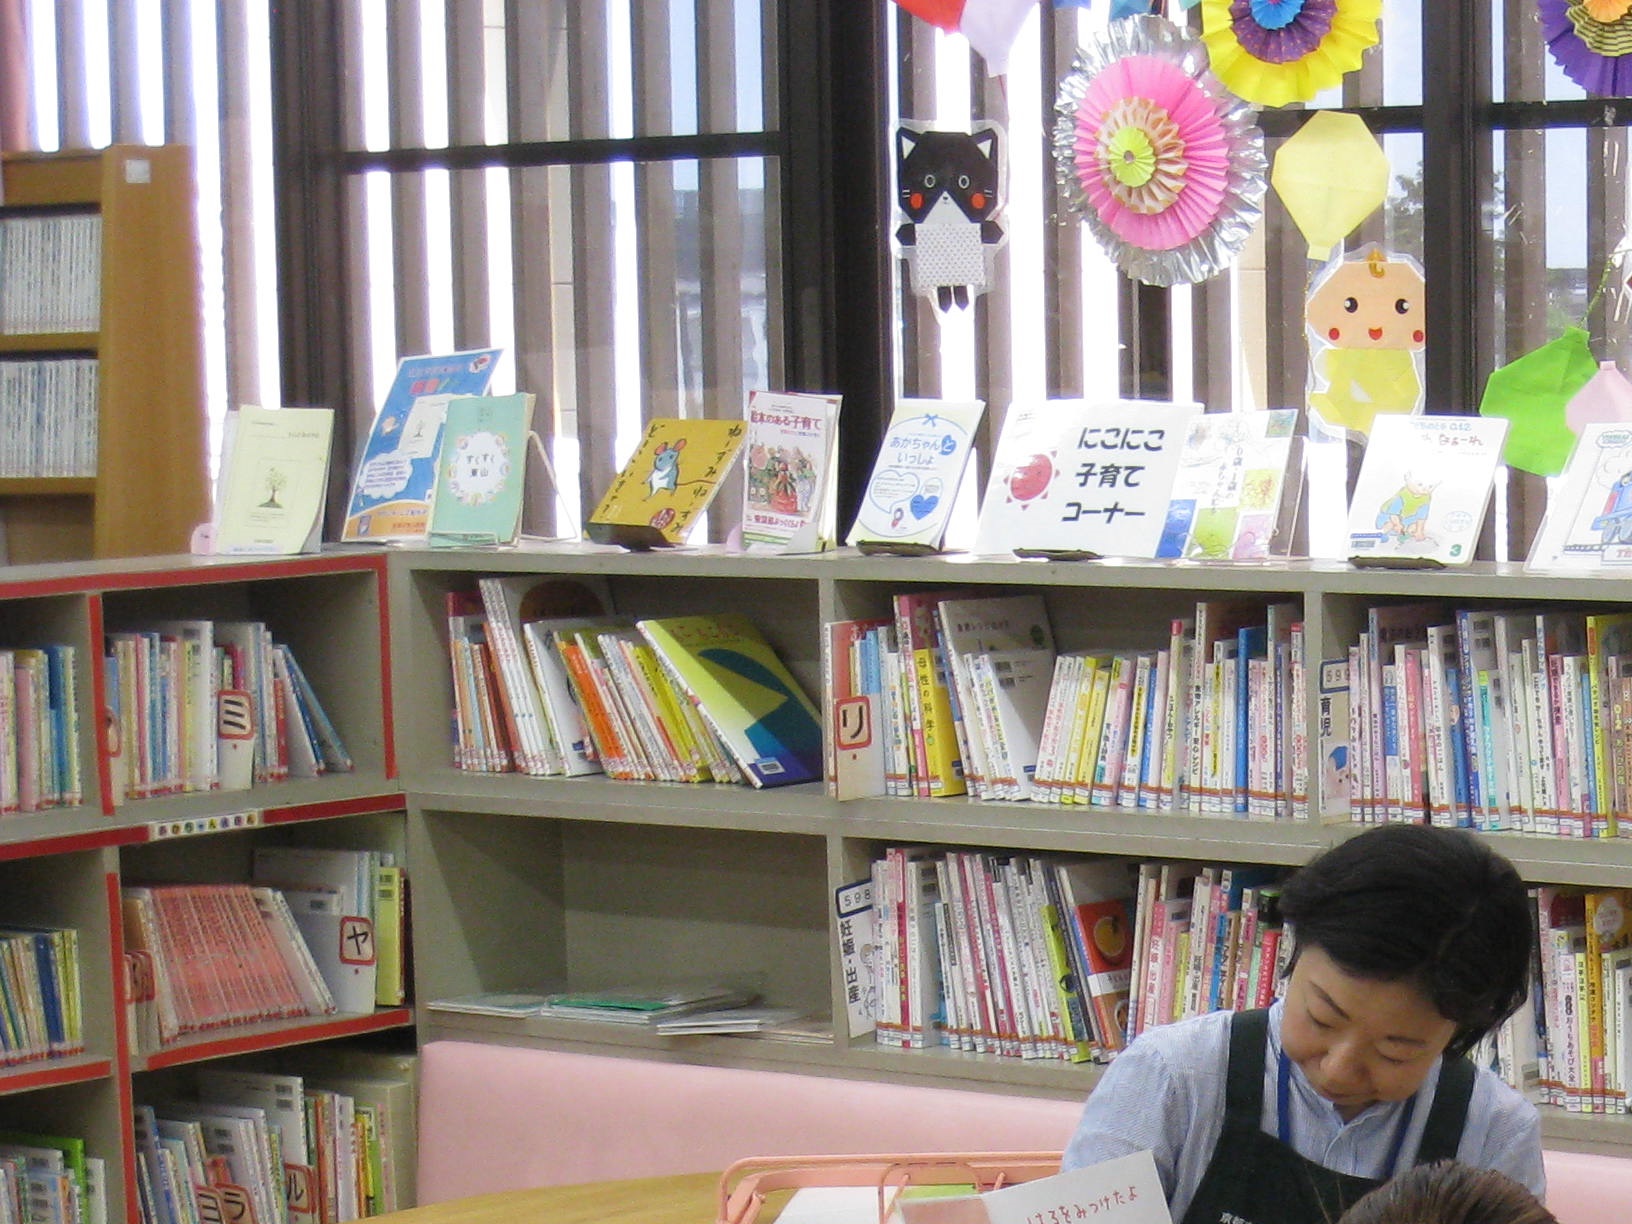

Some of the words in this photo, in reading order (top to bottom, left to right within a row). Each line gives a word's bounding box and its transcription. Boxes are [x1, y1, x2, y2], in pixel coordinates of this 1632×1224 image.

[1077, 427, 1165, 451] にこにこ
[896, 453, 935, 465] いっしょ
[1075, 463, 1146, 488] 子育て
[1061, 501, 1146, 524] コーナー
[1449, 543, 1462, 557] 3
[223, 699, 245, 731] ミ
[842, 704, 864, 739] リ
[1320, 697, 1332, 738] 育児
